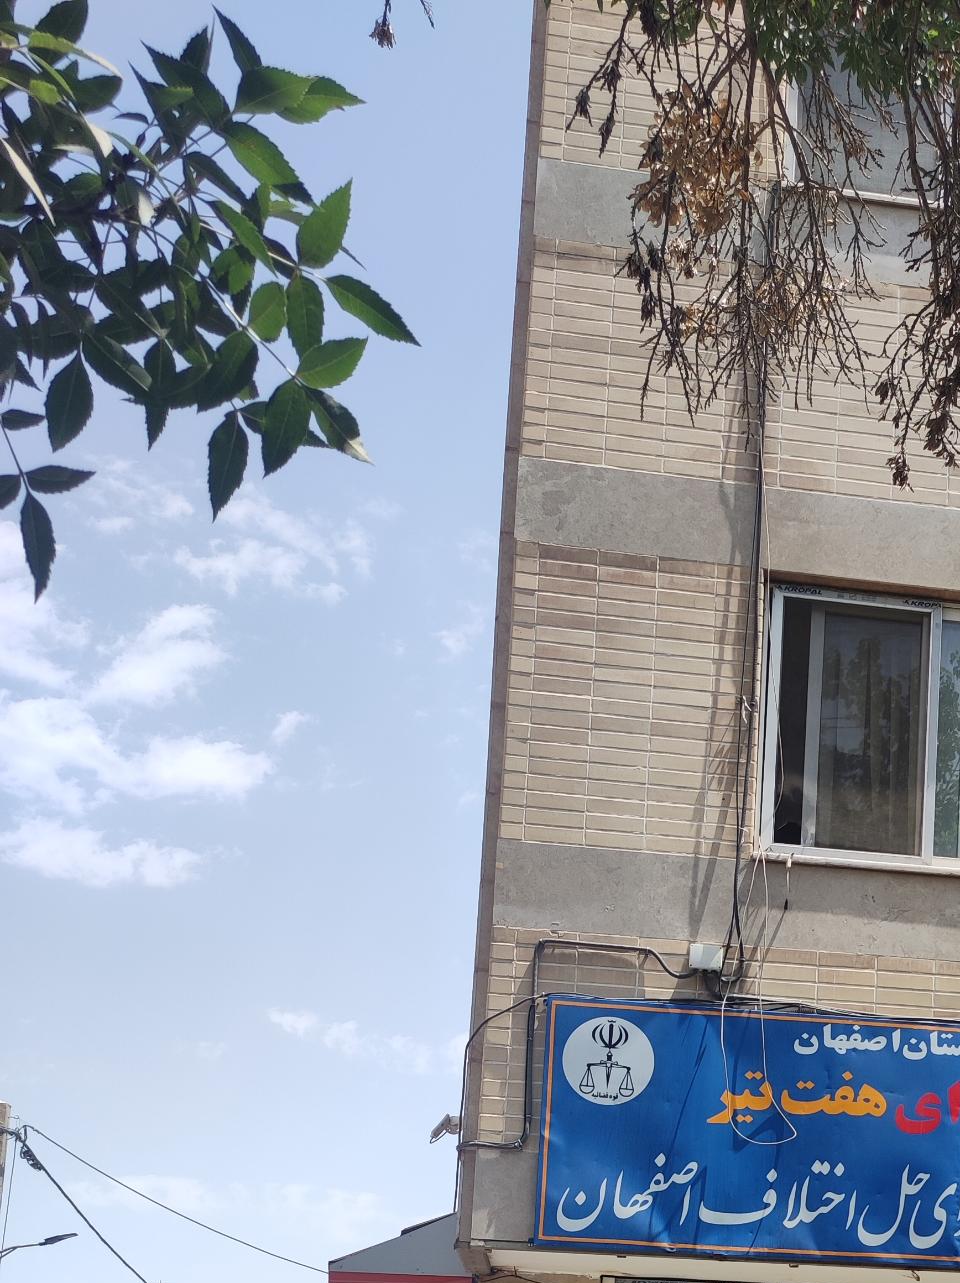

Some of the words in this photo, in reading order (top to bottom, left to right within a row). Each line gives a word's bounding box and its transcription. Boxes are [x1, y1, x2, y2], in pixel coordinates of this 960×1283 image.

[793, 1023, 901, 1056] اصفهان
[705, 1069, 773, 1125] تیر
[779, 1070, 888, 1118] هفت
[555, 1151, 702, 1233] اصفهان
[698, 1158, 858, 1231] اختلاف
[856, 1163, 932, 1248] حل
